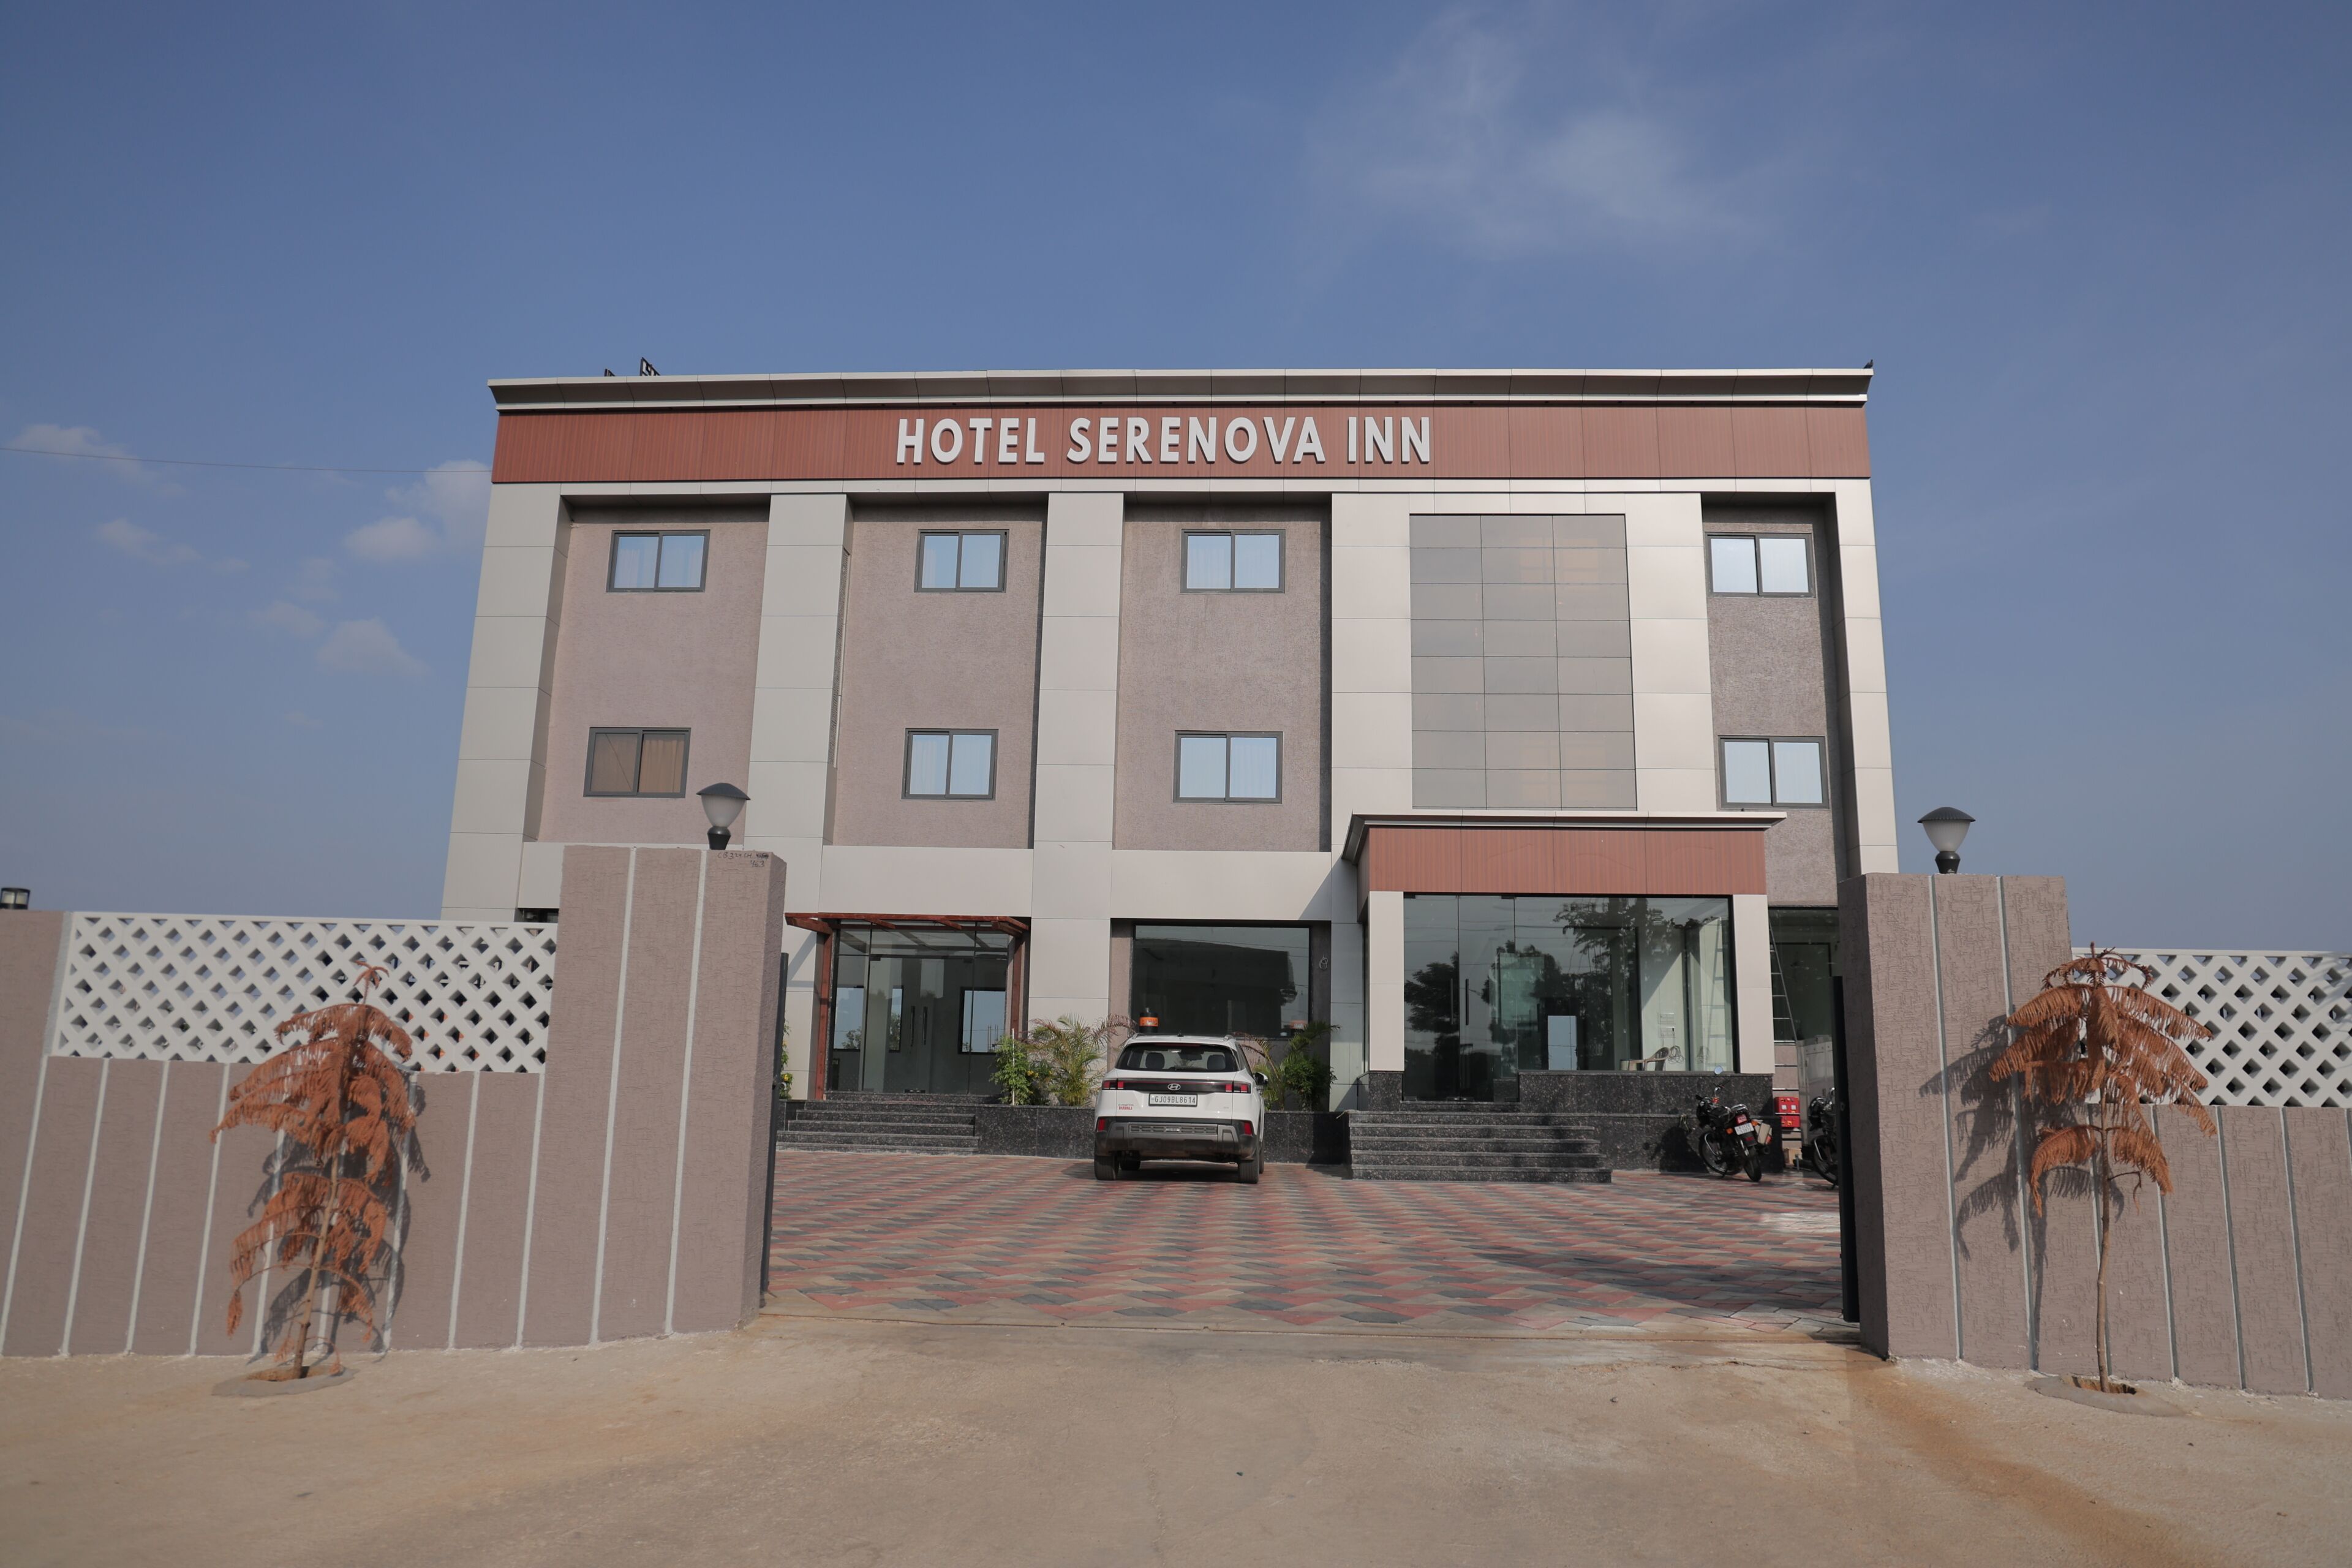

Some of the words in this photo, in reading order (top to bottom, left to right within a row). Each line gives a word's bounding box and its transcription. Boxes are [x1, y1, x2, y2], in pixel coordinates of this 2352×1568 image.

[896, 418, 1044, 464] HOTEL
[1066, 417, 1326, 464] SERENOVA
[1348, 417, 1430, 464] INN
